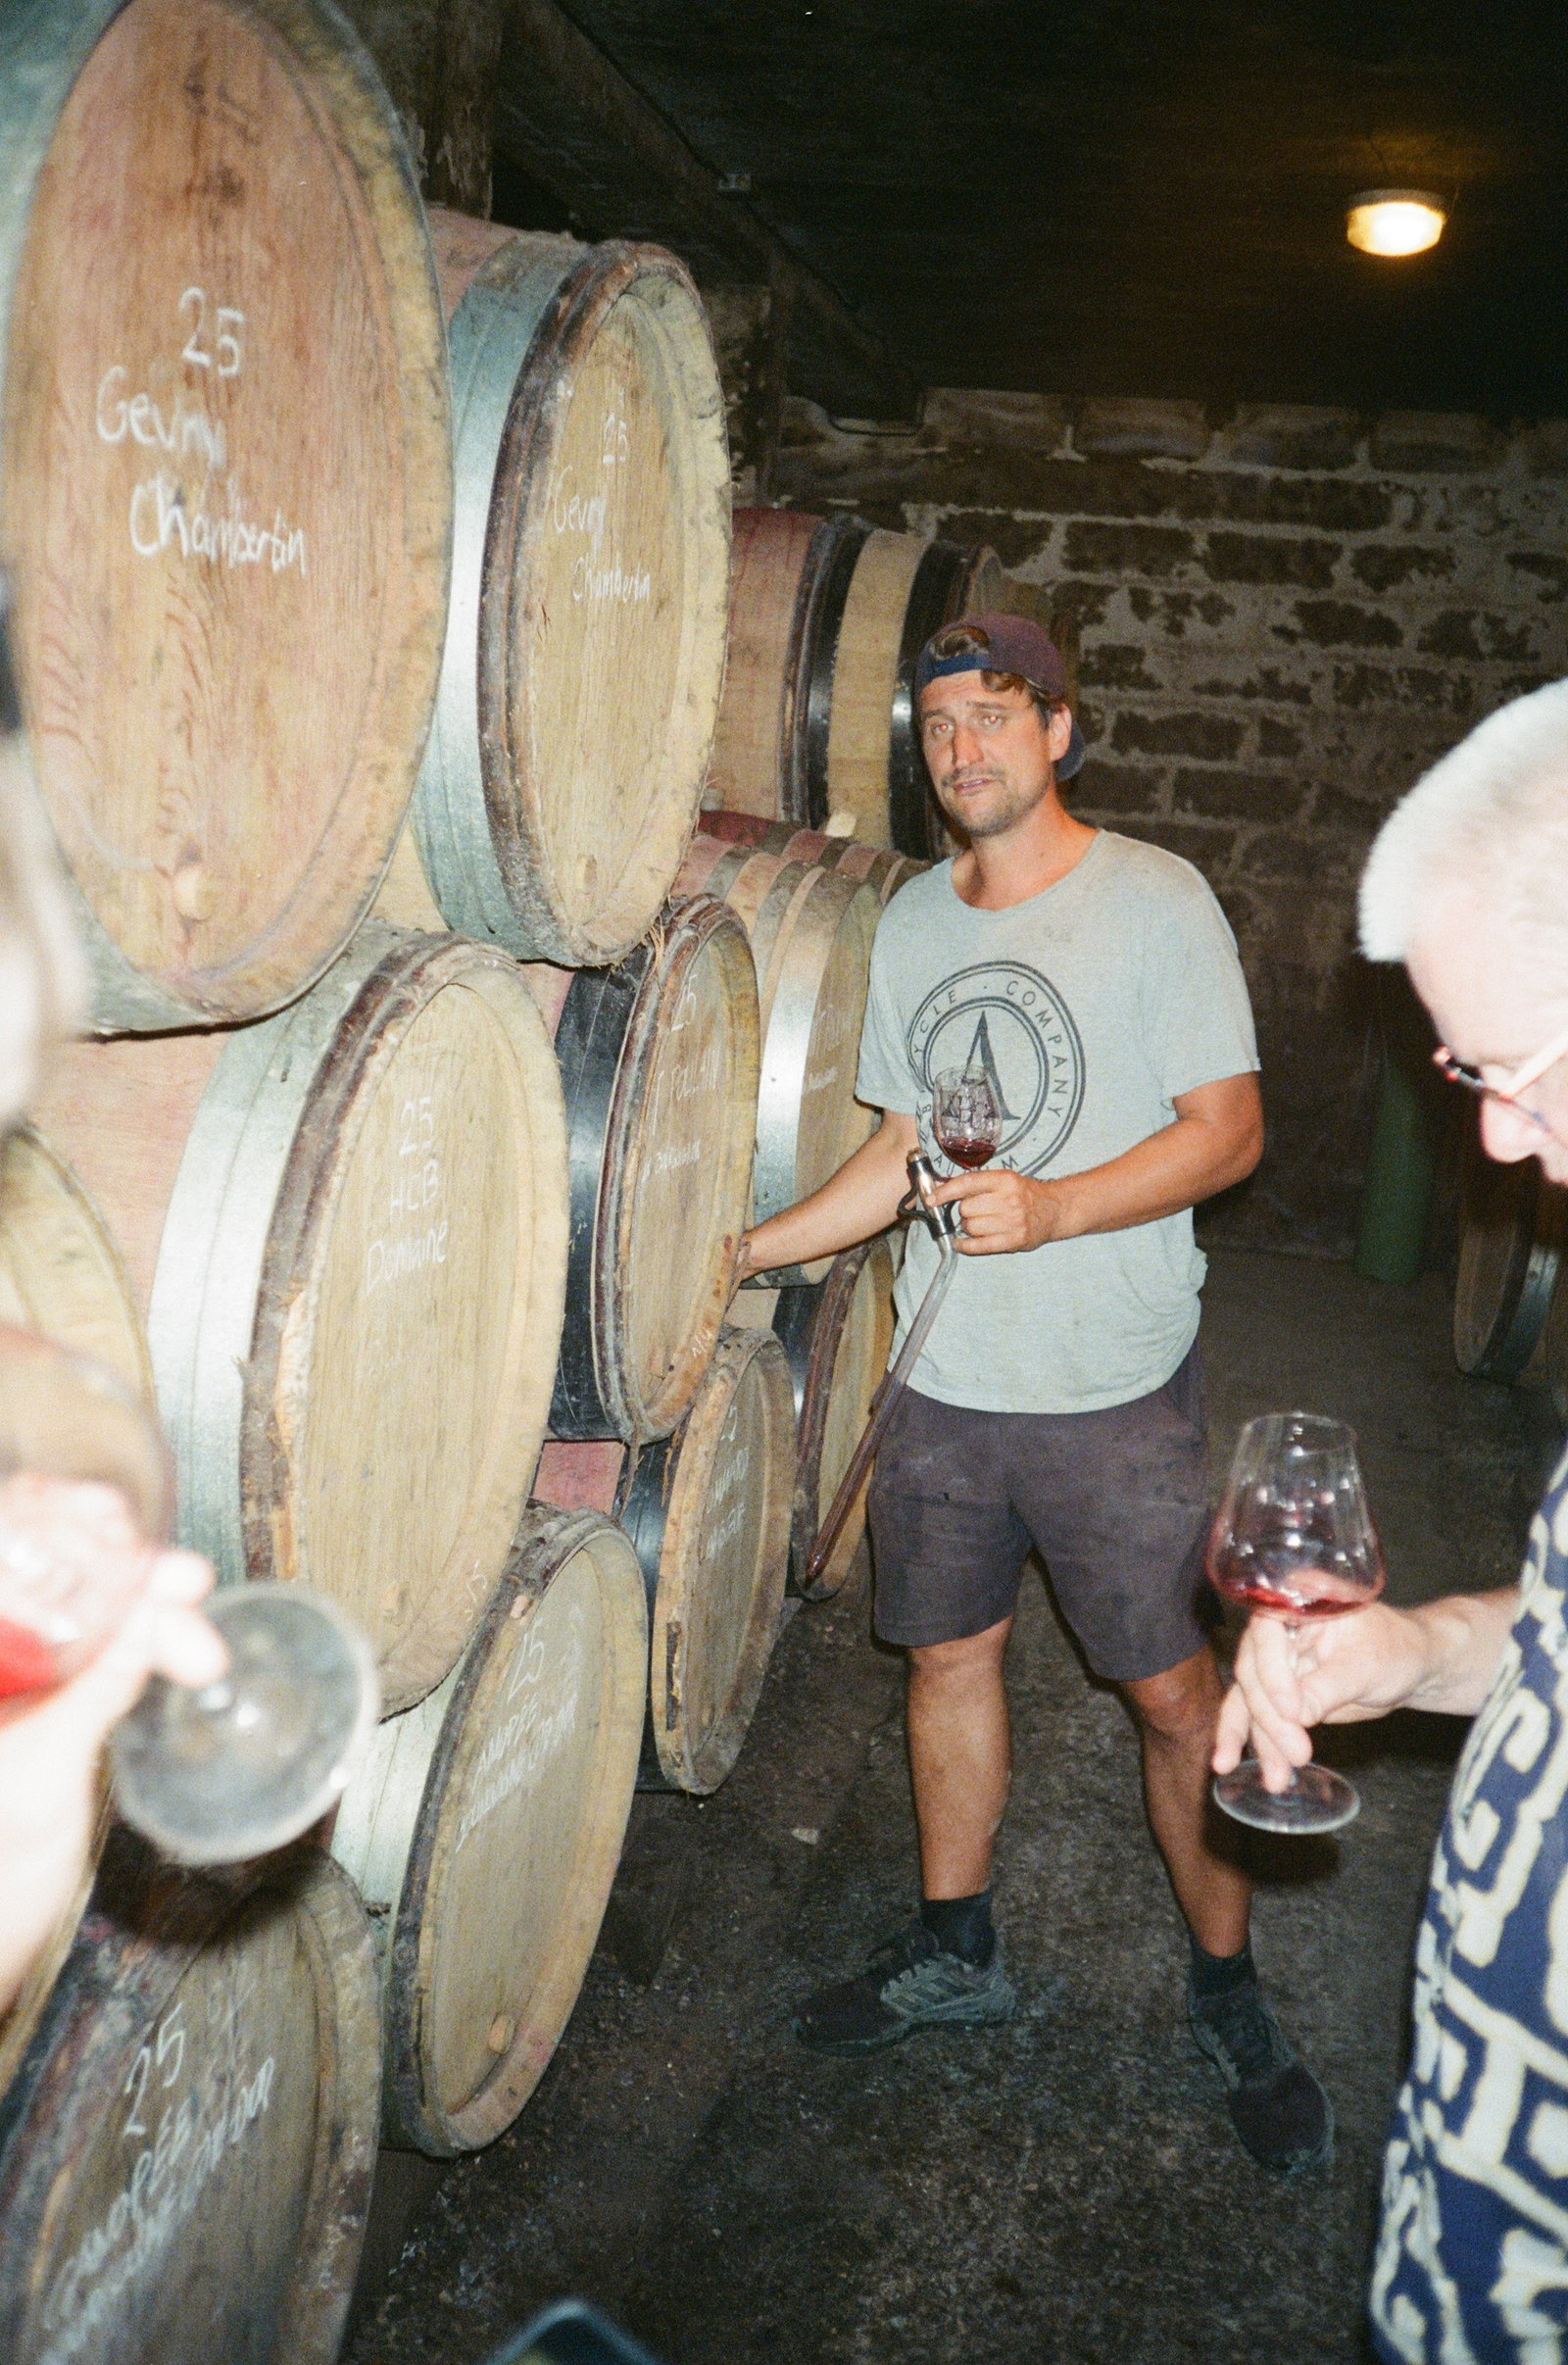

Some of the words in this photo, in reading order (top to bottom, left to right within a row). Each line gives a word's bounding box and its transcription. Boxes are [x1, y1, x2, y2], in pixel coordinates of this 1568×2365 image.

[178, 287, 244, 376] 25
[1005, 980, 1069, 1118] COMPANY
[399, 1096, 434, 1155] 25
[124, 2002, 184, 2135] 25
